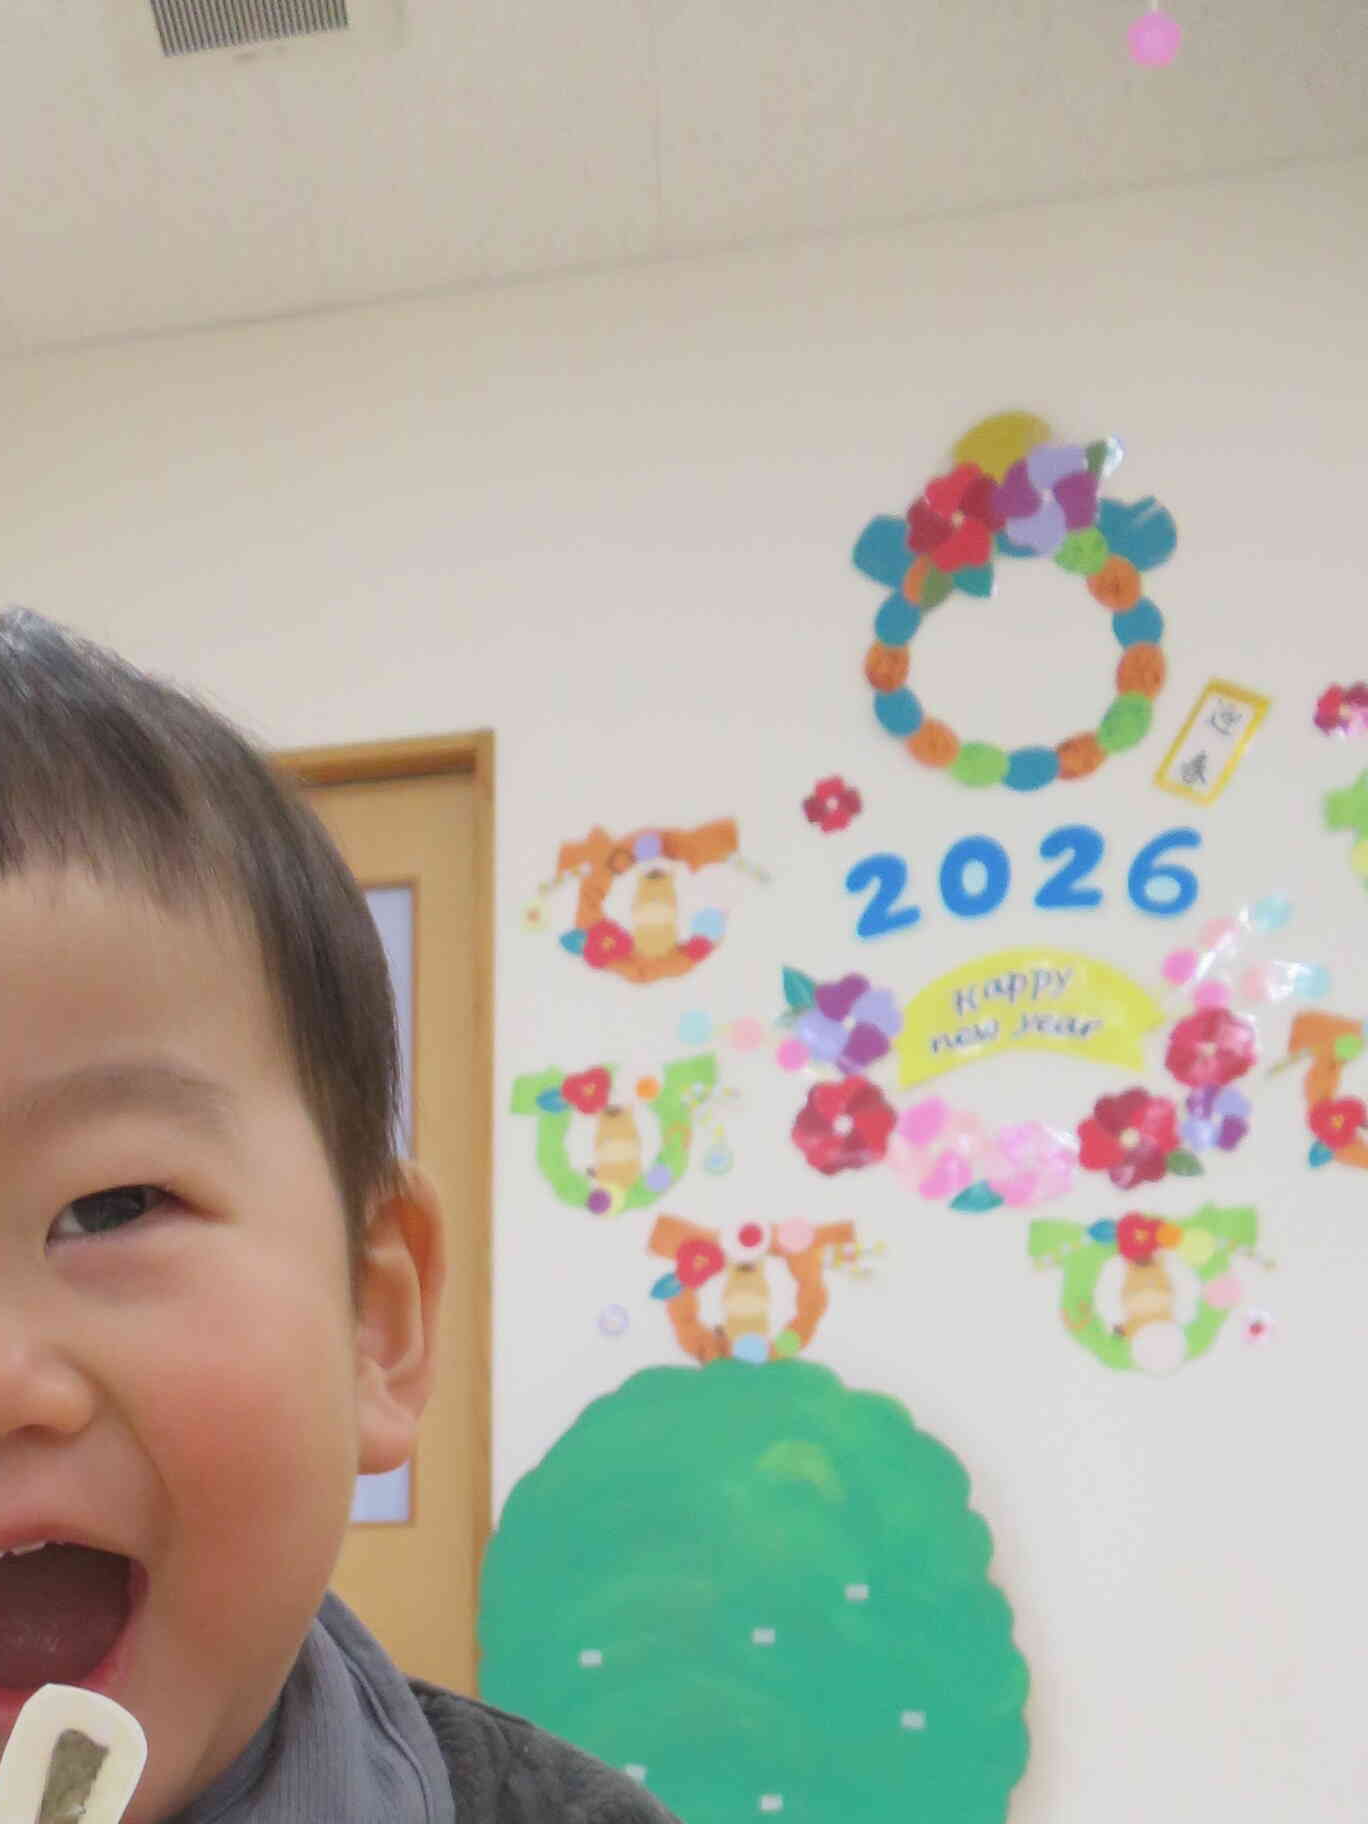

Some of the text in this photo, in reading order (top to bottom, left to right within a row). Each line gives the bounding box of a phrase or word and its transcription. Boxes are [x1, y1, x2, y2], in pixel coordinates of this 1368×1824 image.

[845, 822, 1203, 939] 2026
[928, 1011, 1104, 1053] new year
